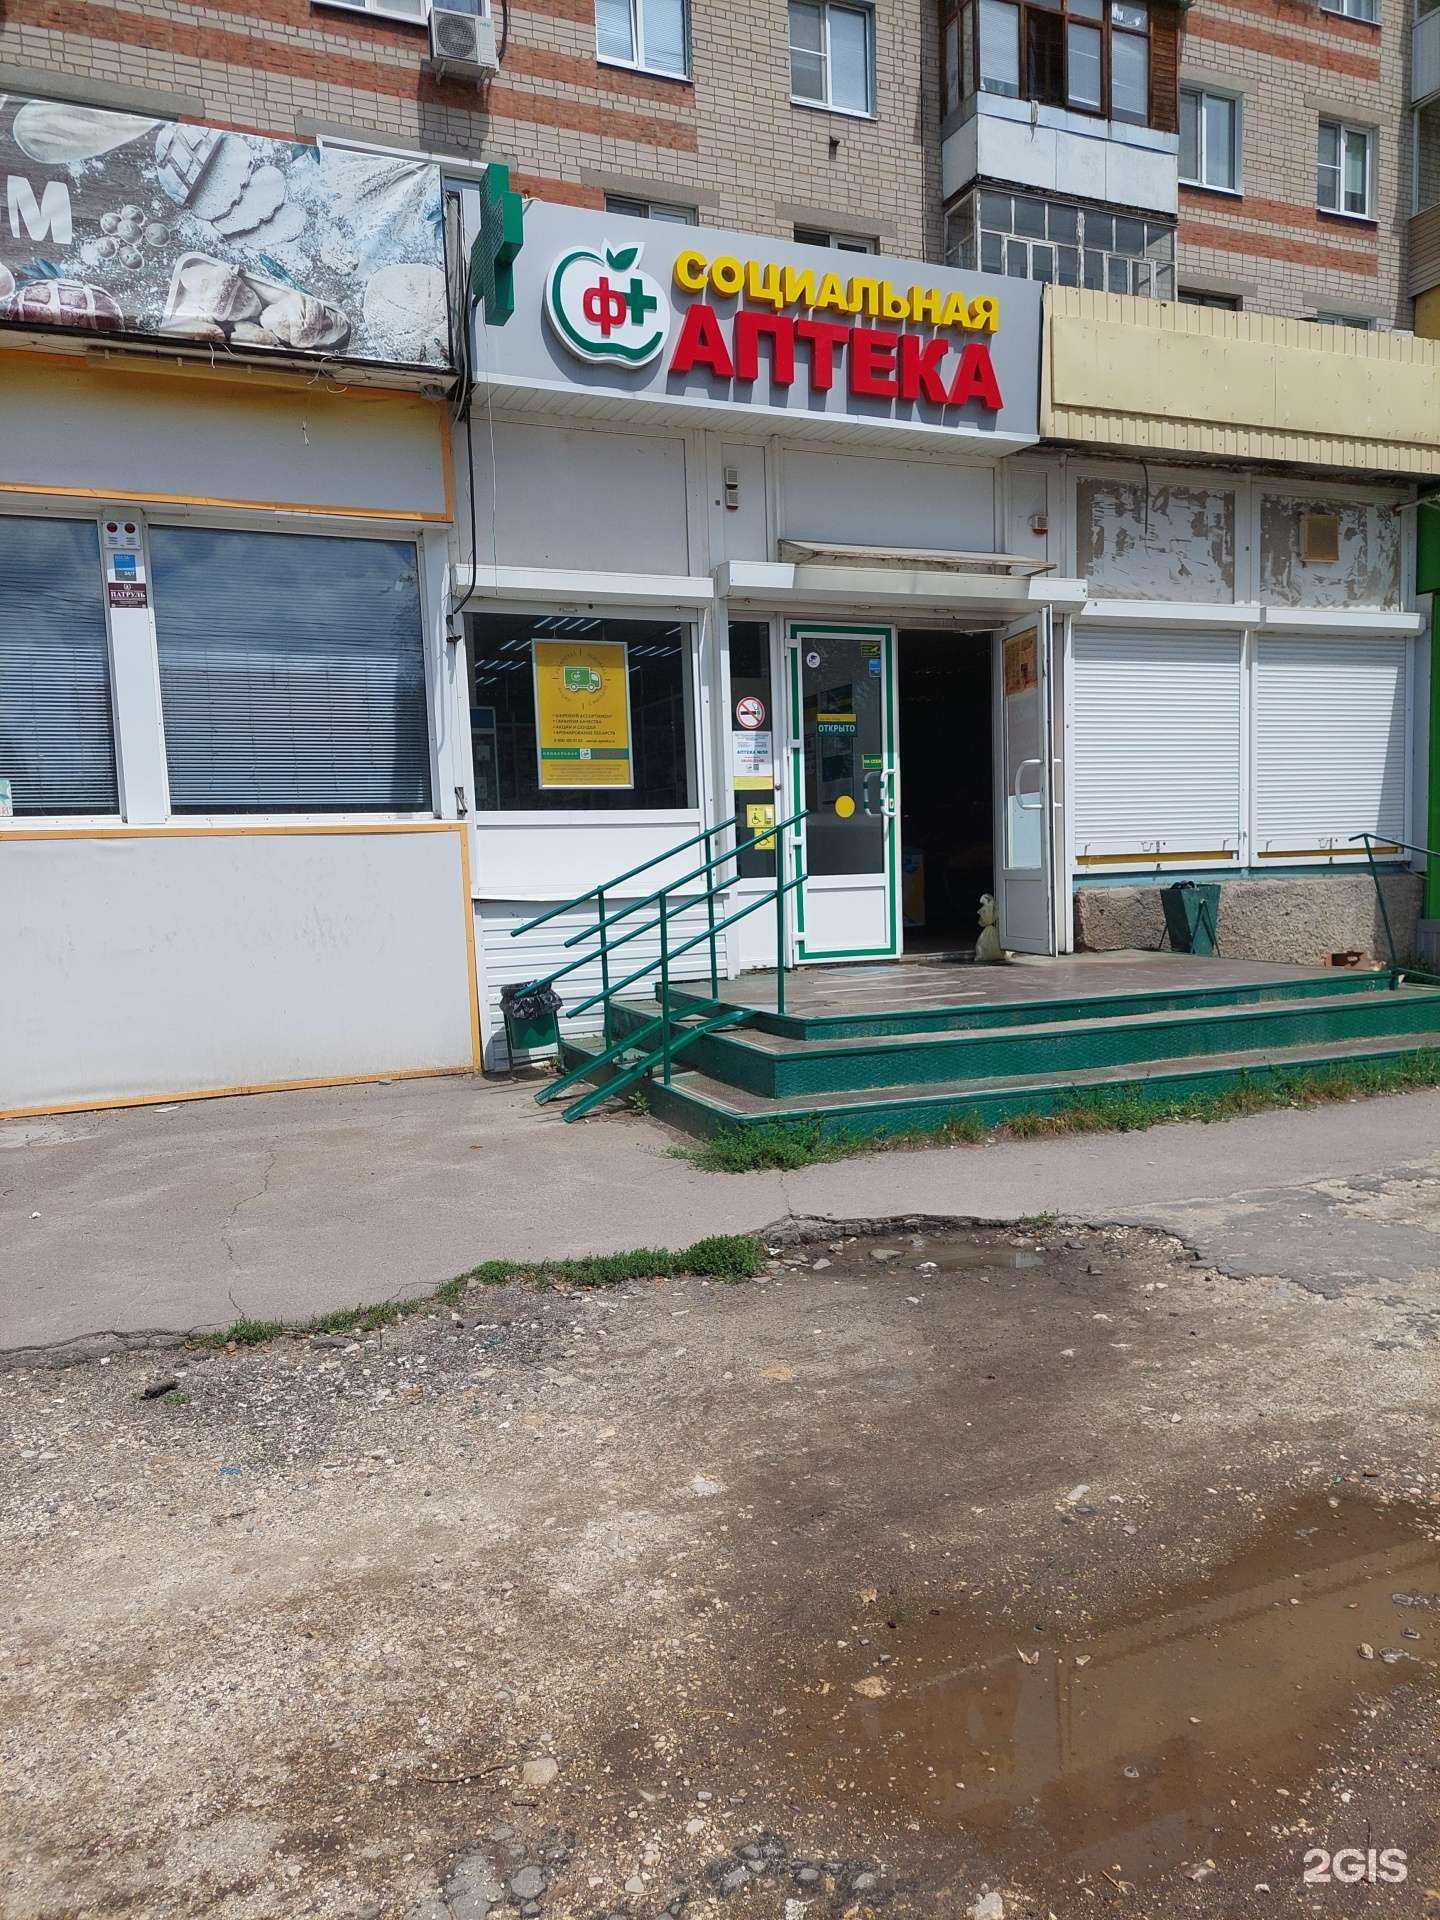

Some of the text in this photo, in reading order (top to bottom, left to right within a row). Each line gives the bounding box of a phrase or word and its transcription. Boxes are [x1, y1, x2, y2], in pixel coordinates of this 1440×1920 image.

[673, 249, 1000, 335] СОЦИАЛЬНАЯ
[668, 303, 1005, 411] АПТЕКА
[818, 724, 856, 733] ОТКРЫТО
